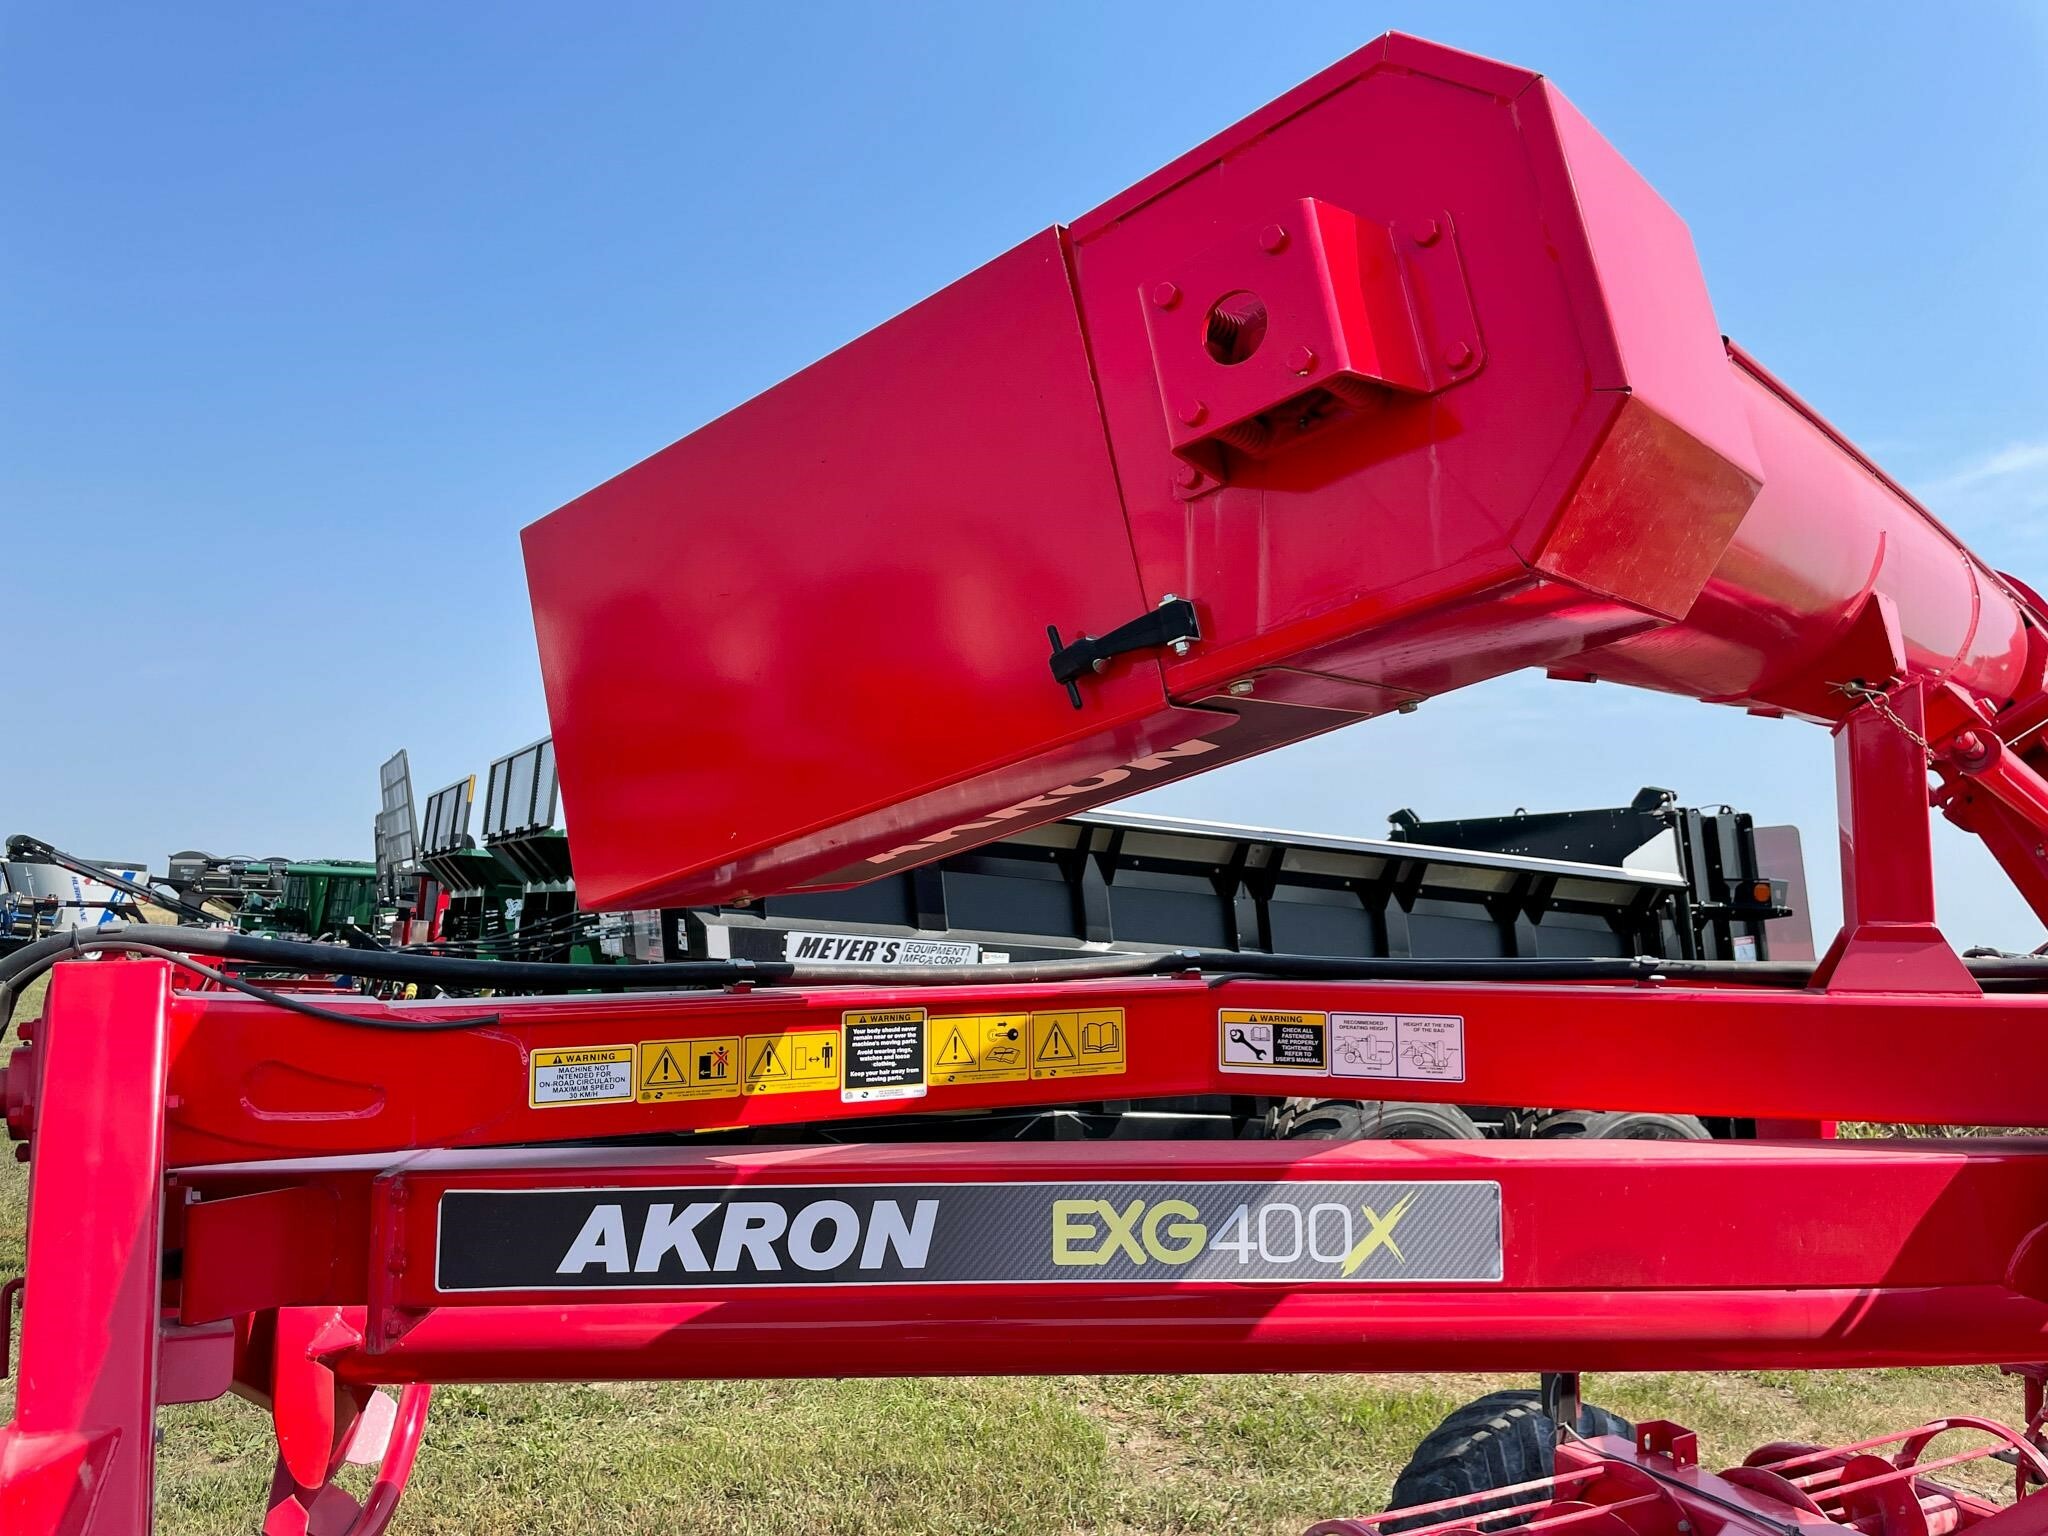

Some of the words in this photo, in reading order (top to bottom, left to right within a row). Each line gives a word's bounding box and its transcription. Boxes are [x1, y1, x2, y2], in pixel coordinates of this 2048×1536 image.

[795, 936, 900, 963] MEYER'S
[906, 944, 967, 956] EQUIPMENT
[871, 1014, 911, 1022] WARNING
[566, 1053, 615, 1062] WARNING
[557, 1072, 594, 1080] INTENDED
[577, 1077, 625, 1085] CIRCULATION
[553, 1085, 588, 1093] MAXIMUM
[556, 1200, 940, 1273] AKRON
